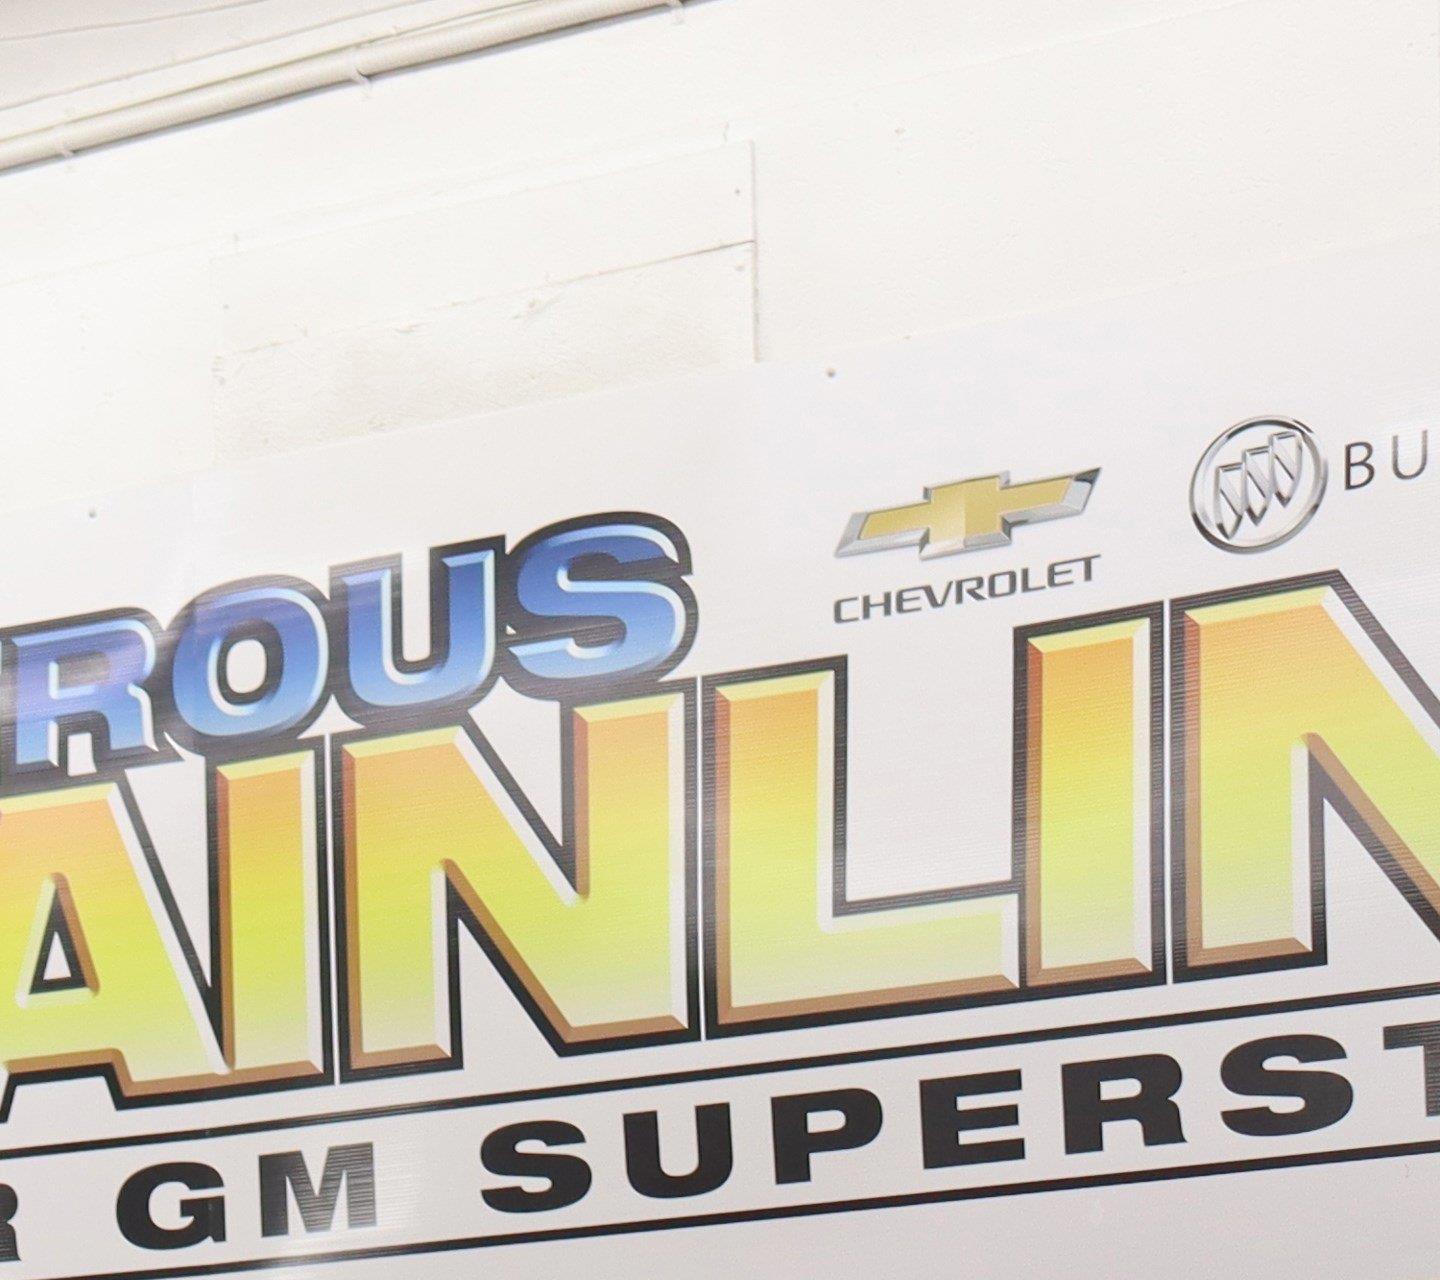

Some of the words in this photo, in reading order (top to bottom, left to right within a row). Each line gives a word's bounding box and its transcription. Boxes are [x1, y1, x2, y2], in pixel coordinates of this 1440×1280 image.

[1344, 429, 1429, 491] BU
[833, 553, 1102, 624] CHEVROLET
[115, 1140, 378, 1250] GM
